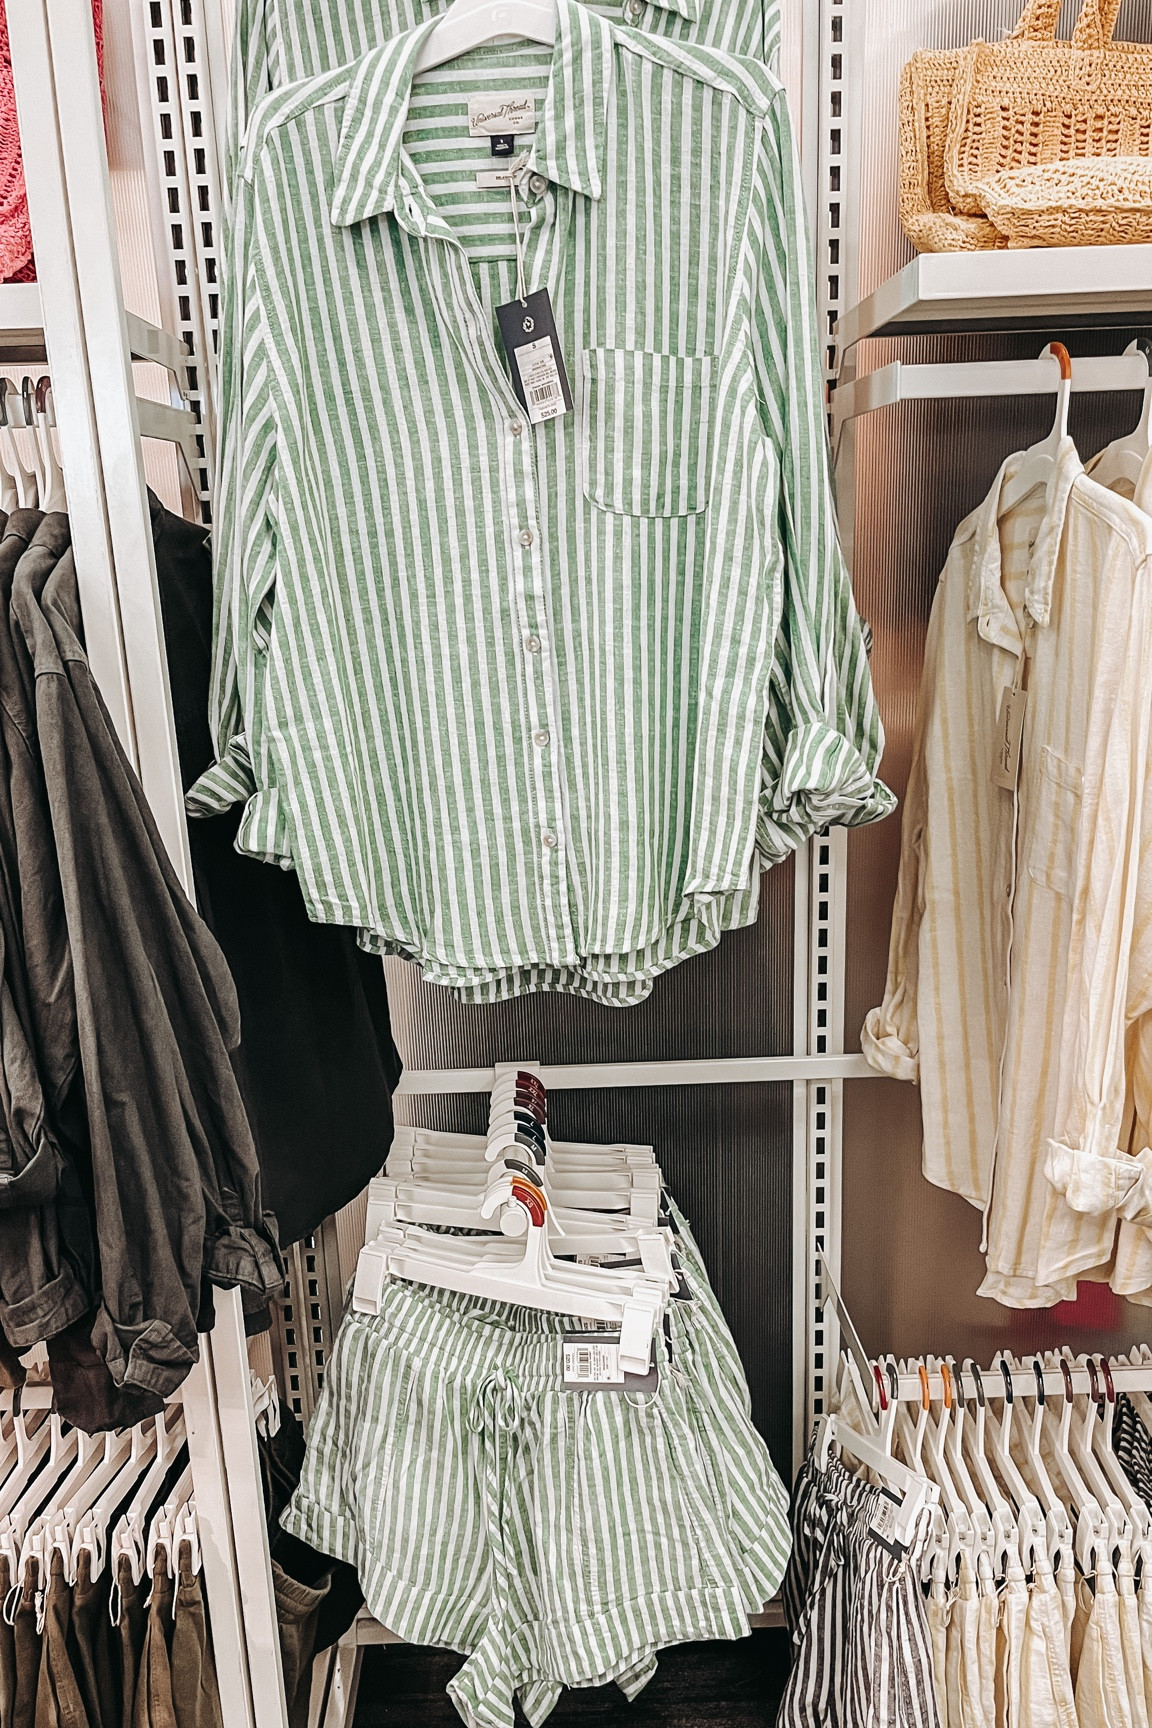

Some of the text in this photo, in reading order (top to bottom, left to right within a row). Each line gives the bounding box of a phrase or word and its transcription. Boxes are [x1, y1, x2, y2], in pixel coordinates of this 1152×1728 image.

[471, 100, 529, 127] Universal Thread
[540, 408, 558, 418] $25.00
[528, 1087, 538, 1097] XXL
[527, 1104, 534, 1112] XL
[530, 1144, 537, 1152] M
[524, 1198, 534, 1209] XS
